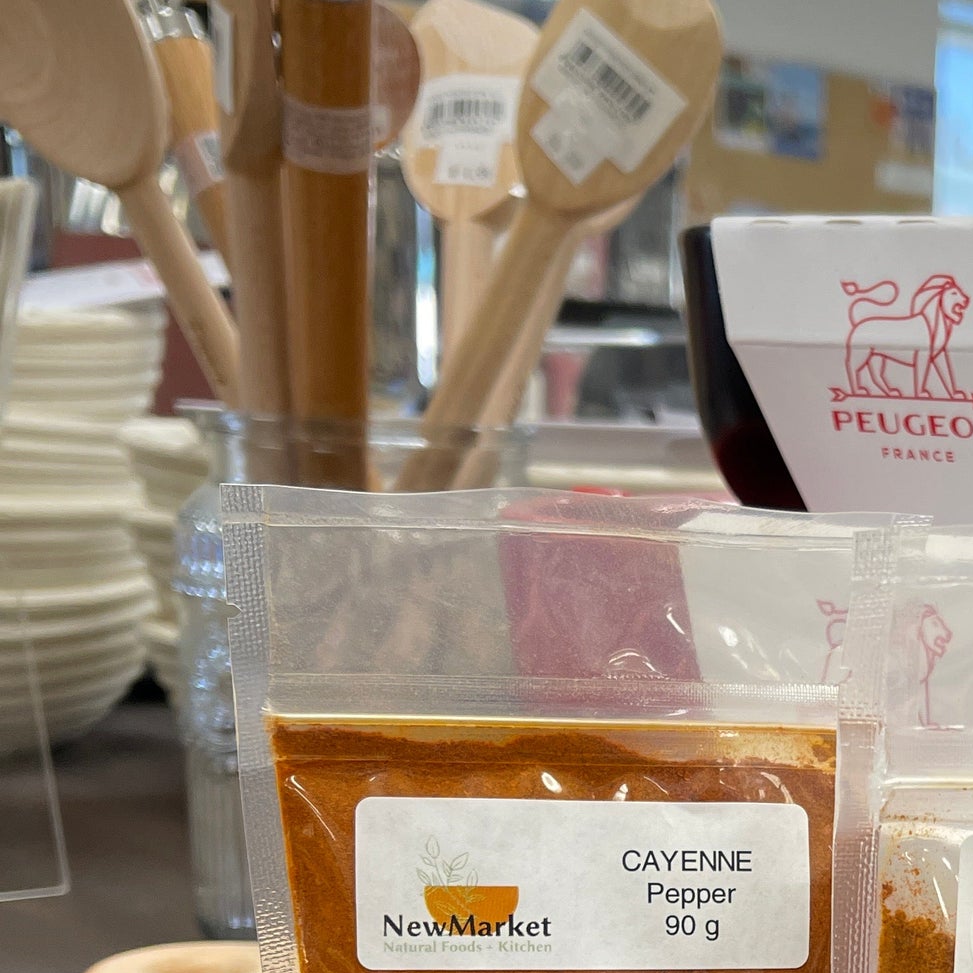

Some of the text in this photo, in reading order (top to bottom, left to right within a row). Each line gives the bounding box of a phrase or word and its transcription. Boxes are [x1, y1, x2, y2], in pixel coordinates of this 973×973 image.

[881, 447, 956, 463] FRANCE
[622, 849, 753, 872] CAYENNE
[647, 882, 737, 910] Pepper
[382, 913, 553, 938] NewMarket
[665, 914, 720, 942] 90 g
[383, 940, 438, 954] Natural
[441, 940, 483, 954] Foods
[499, 940, 553, 954] Kitchen
